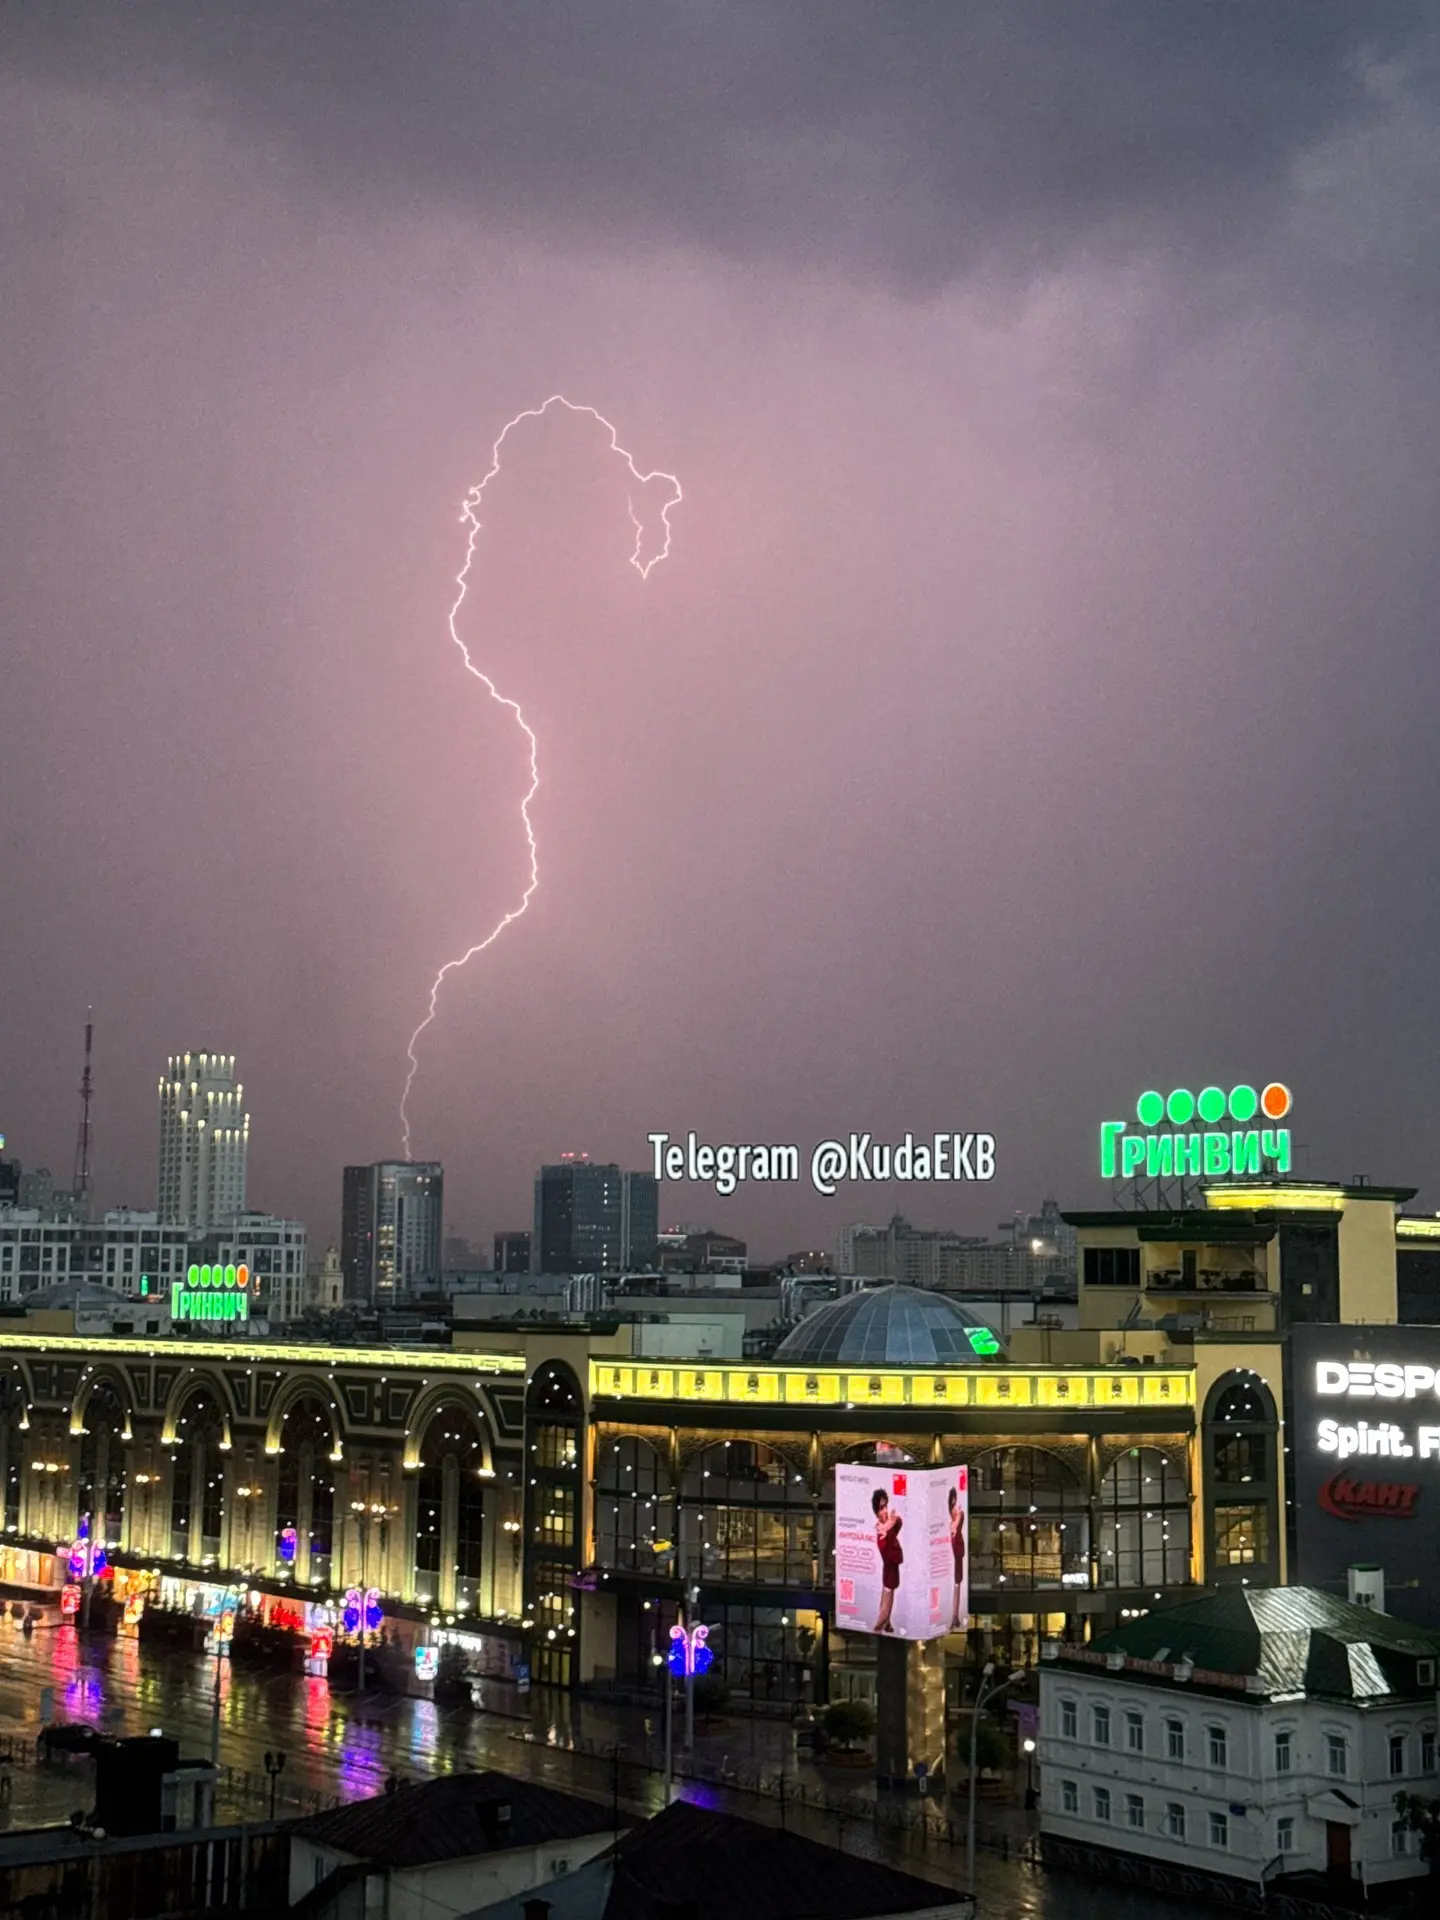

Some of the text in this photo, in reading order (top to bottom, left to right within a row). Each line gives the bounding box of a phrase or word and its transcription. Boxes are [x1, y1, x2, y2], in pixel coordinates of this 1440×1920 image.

[1316, 1361, 1440, 1399] DESP
[1317, 1418, 1440, 1459] Spirit. F
